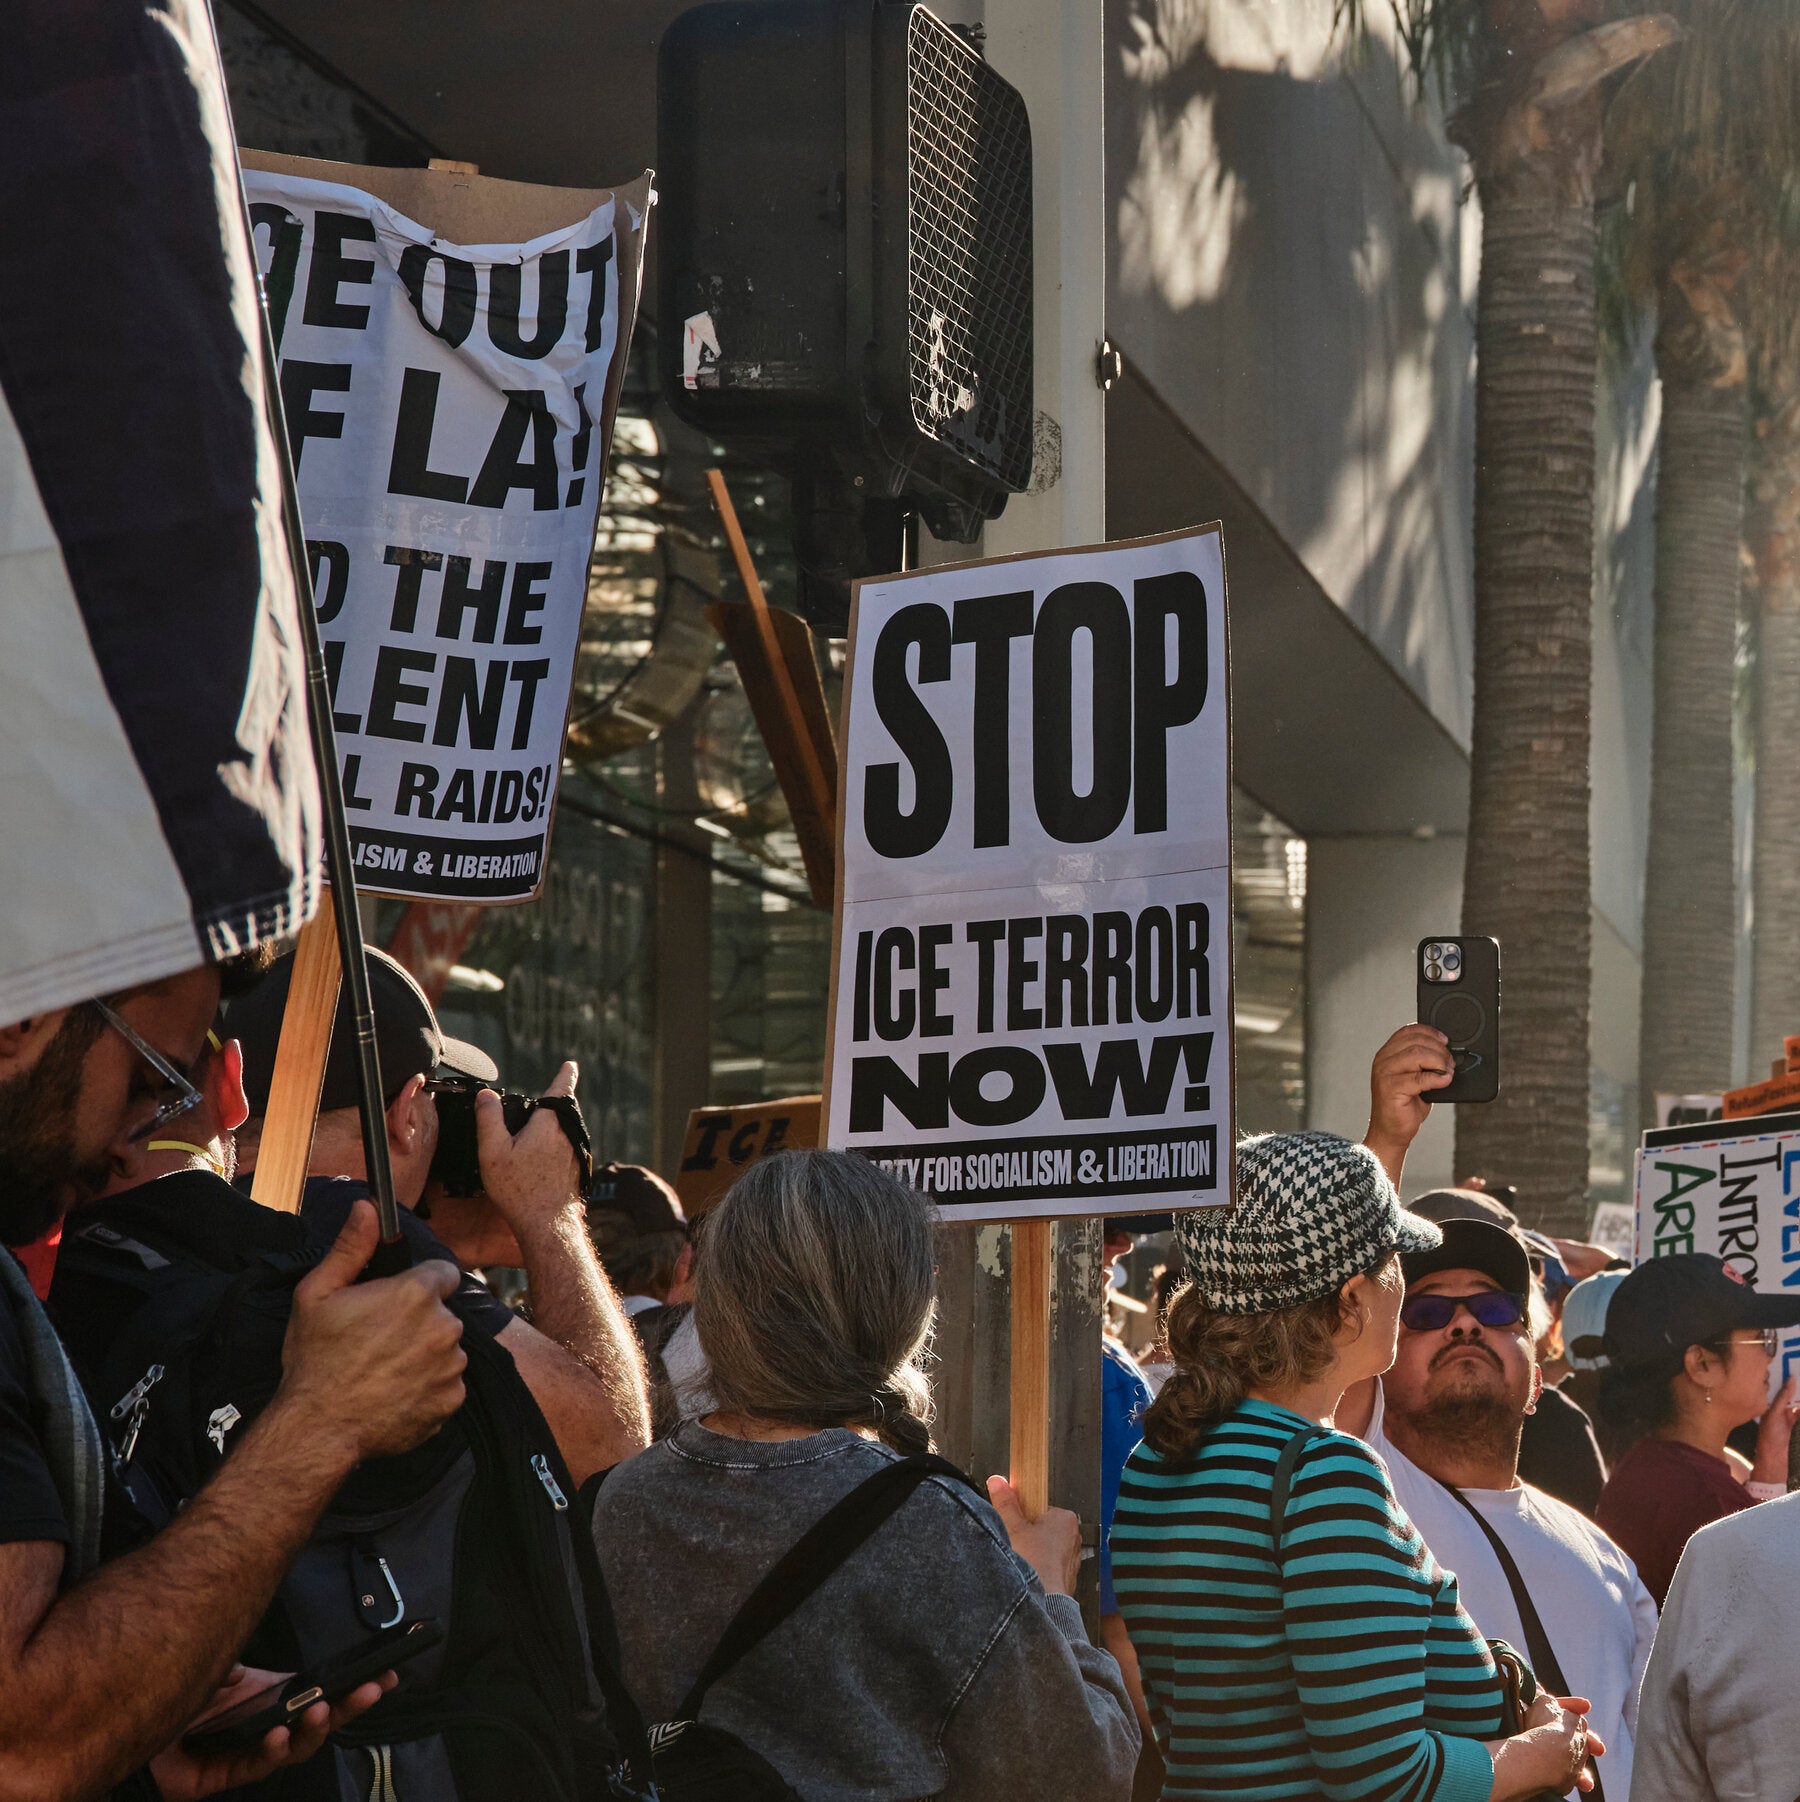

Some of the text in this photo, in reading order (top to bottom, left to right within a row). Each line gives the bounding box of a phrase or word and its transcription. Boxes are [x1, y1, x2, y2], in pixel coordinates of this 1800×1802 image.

[396, 236, 612, 360] OUT
[387, 366, 593, 511] LA!
[383, 545, 553, 645] THE
[864, 571, 1209, 859] STOP
[394, 761, 552, 825] RAIDS!
[413, 851, 434, 875] &
[440, 850, 538, 879] LIBERATION
[853, 902, 1211, 1042] ICE TERROR
[848, 1031, 1215, 1133] NOW!
[922, 1156, 963, 1193] FOR
[965, 1149, 1072, 1191] SOCIALISM
[1077, 1149, 1104, 1184] &
[1107, 1139, 1210, 1182] LIBERATION
[1653, 1161, 1717, 1258] ARE
[1718, 1141, 1782, 1285] INTRO
